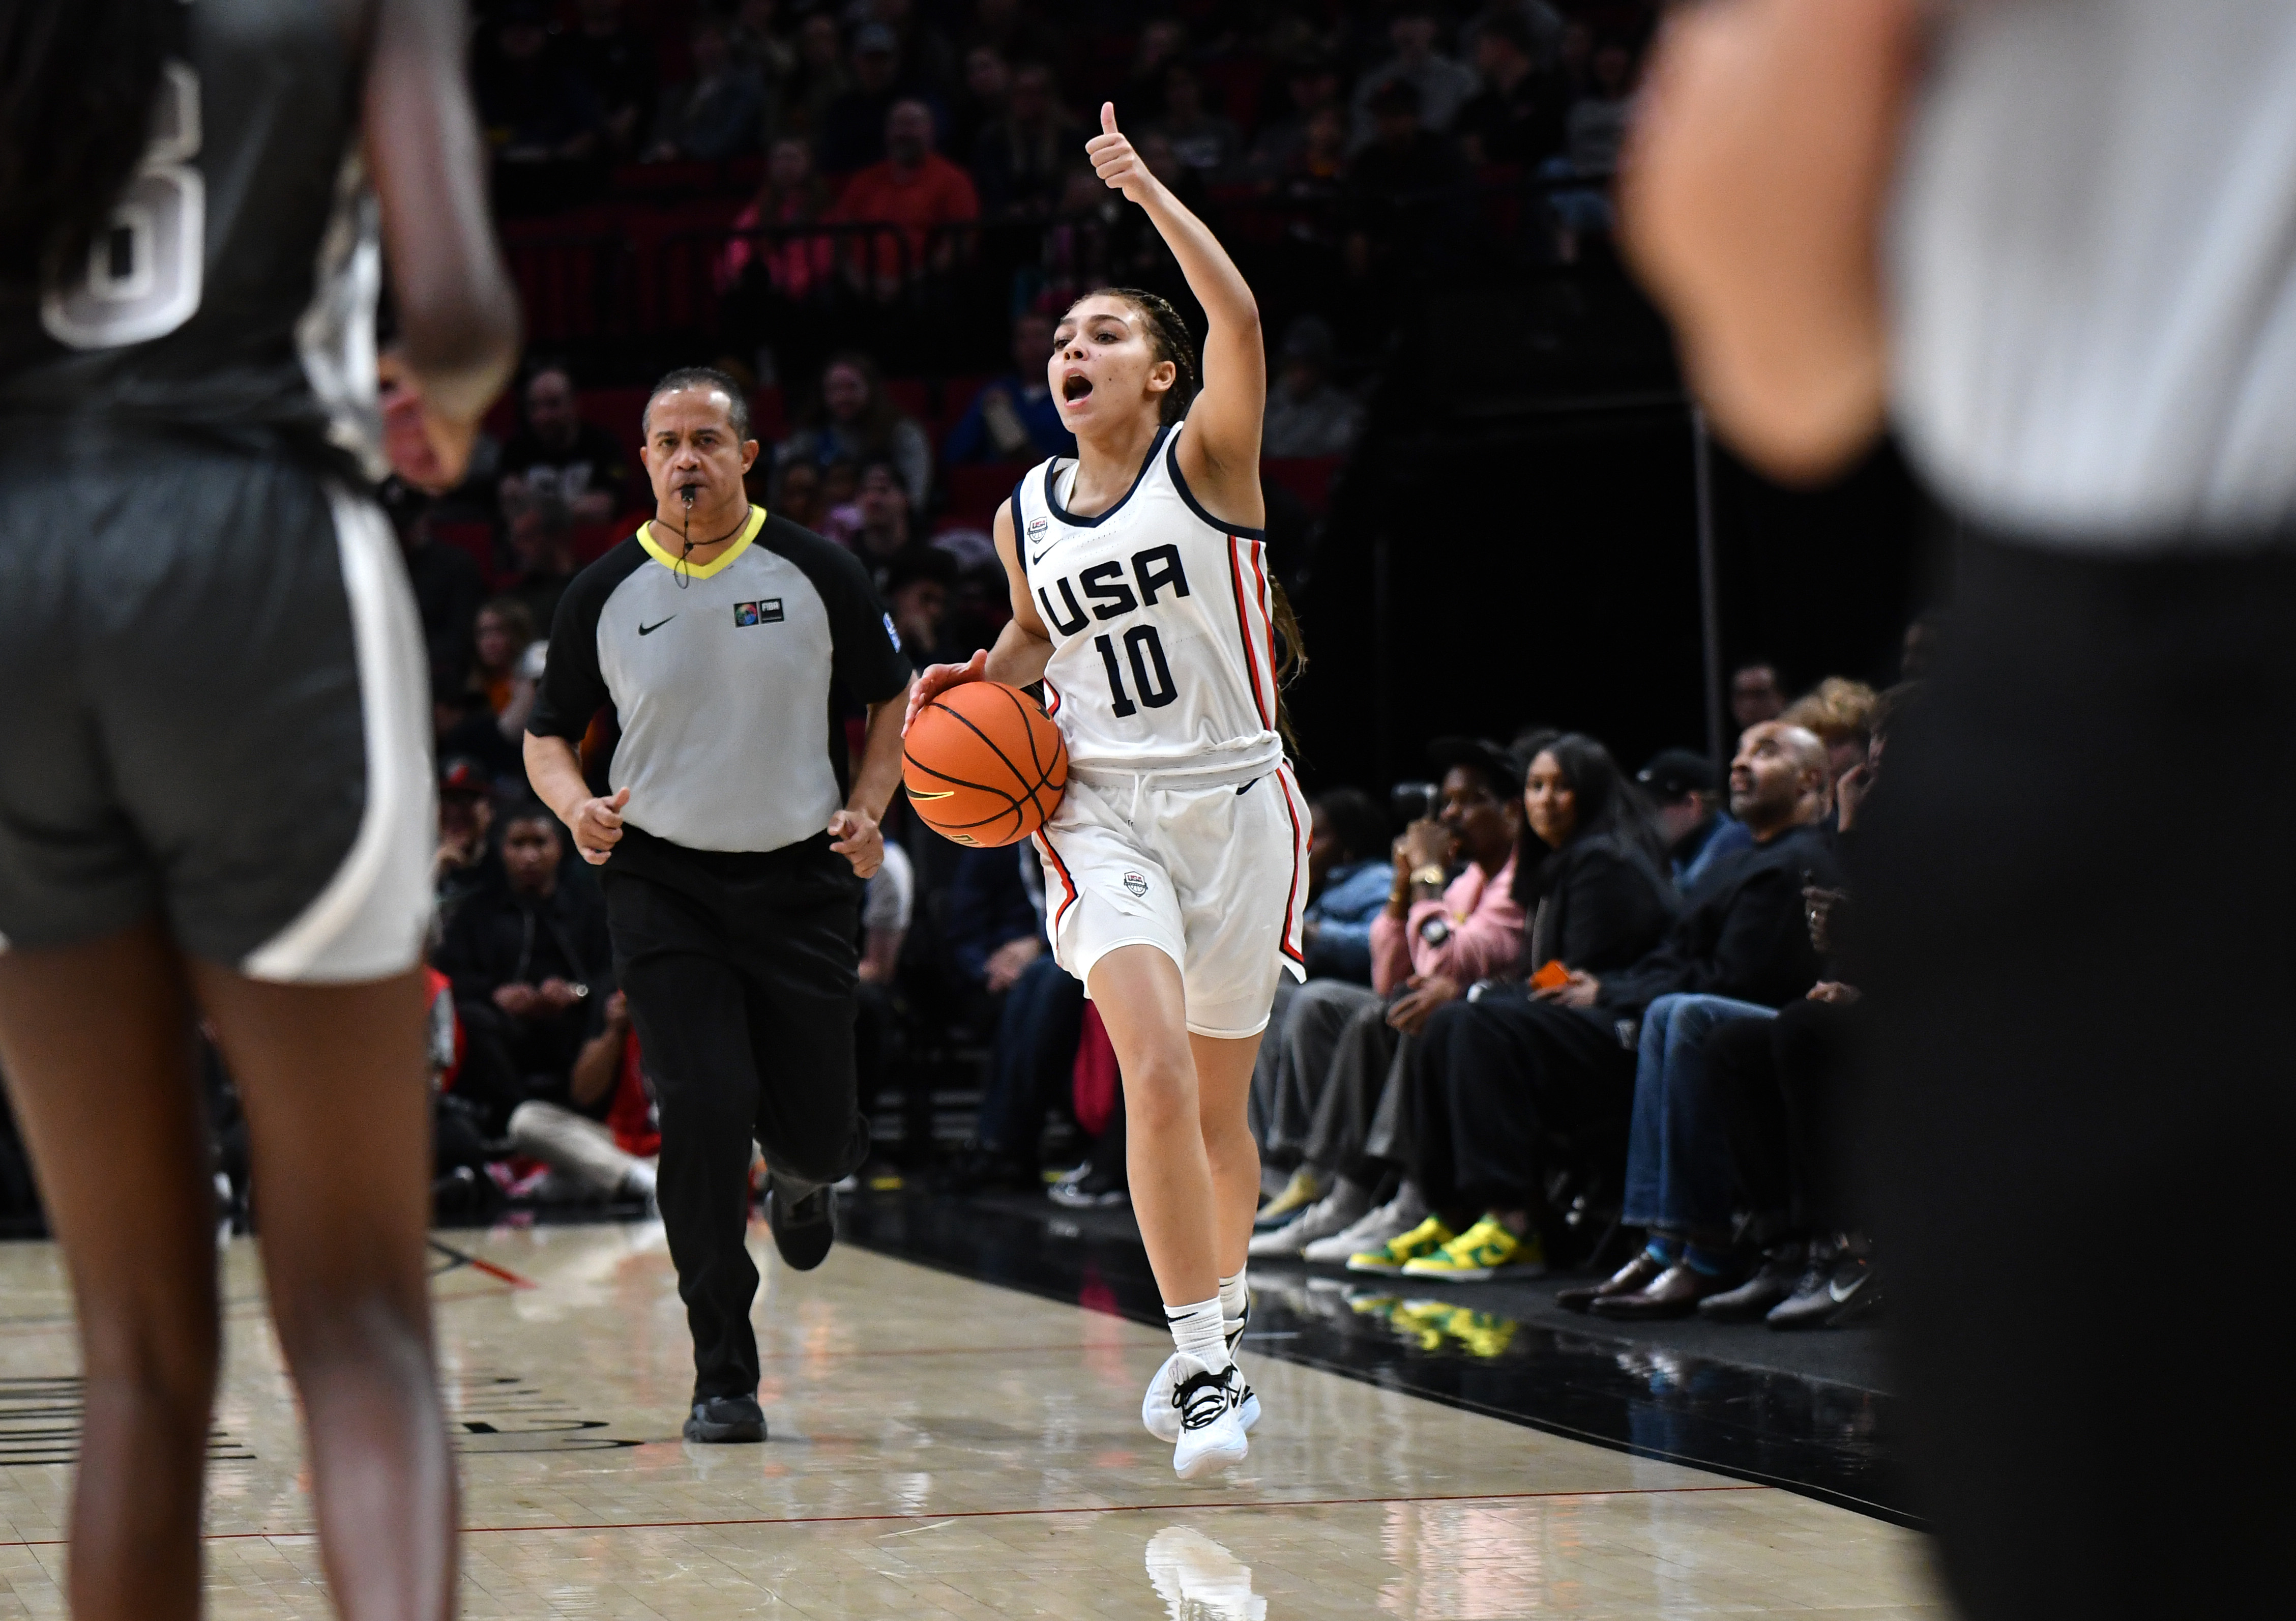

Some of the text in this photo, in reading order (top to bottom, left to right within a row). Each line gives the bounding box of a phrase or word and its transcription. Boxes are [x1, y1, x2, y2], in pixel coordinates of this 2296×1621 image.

[762, 602, 780, 612] FIBA
[1038, 543, 1190, 636] USA
[1094, 624, 1178, 718] 10
